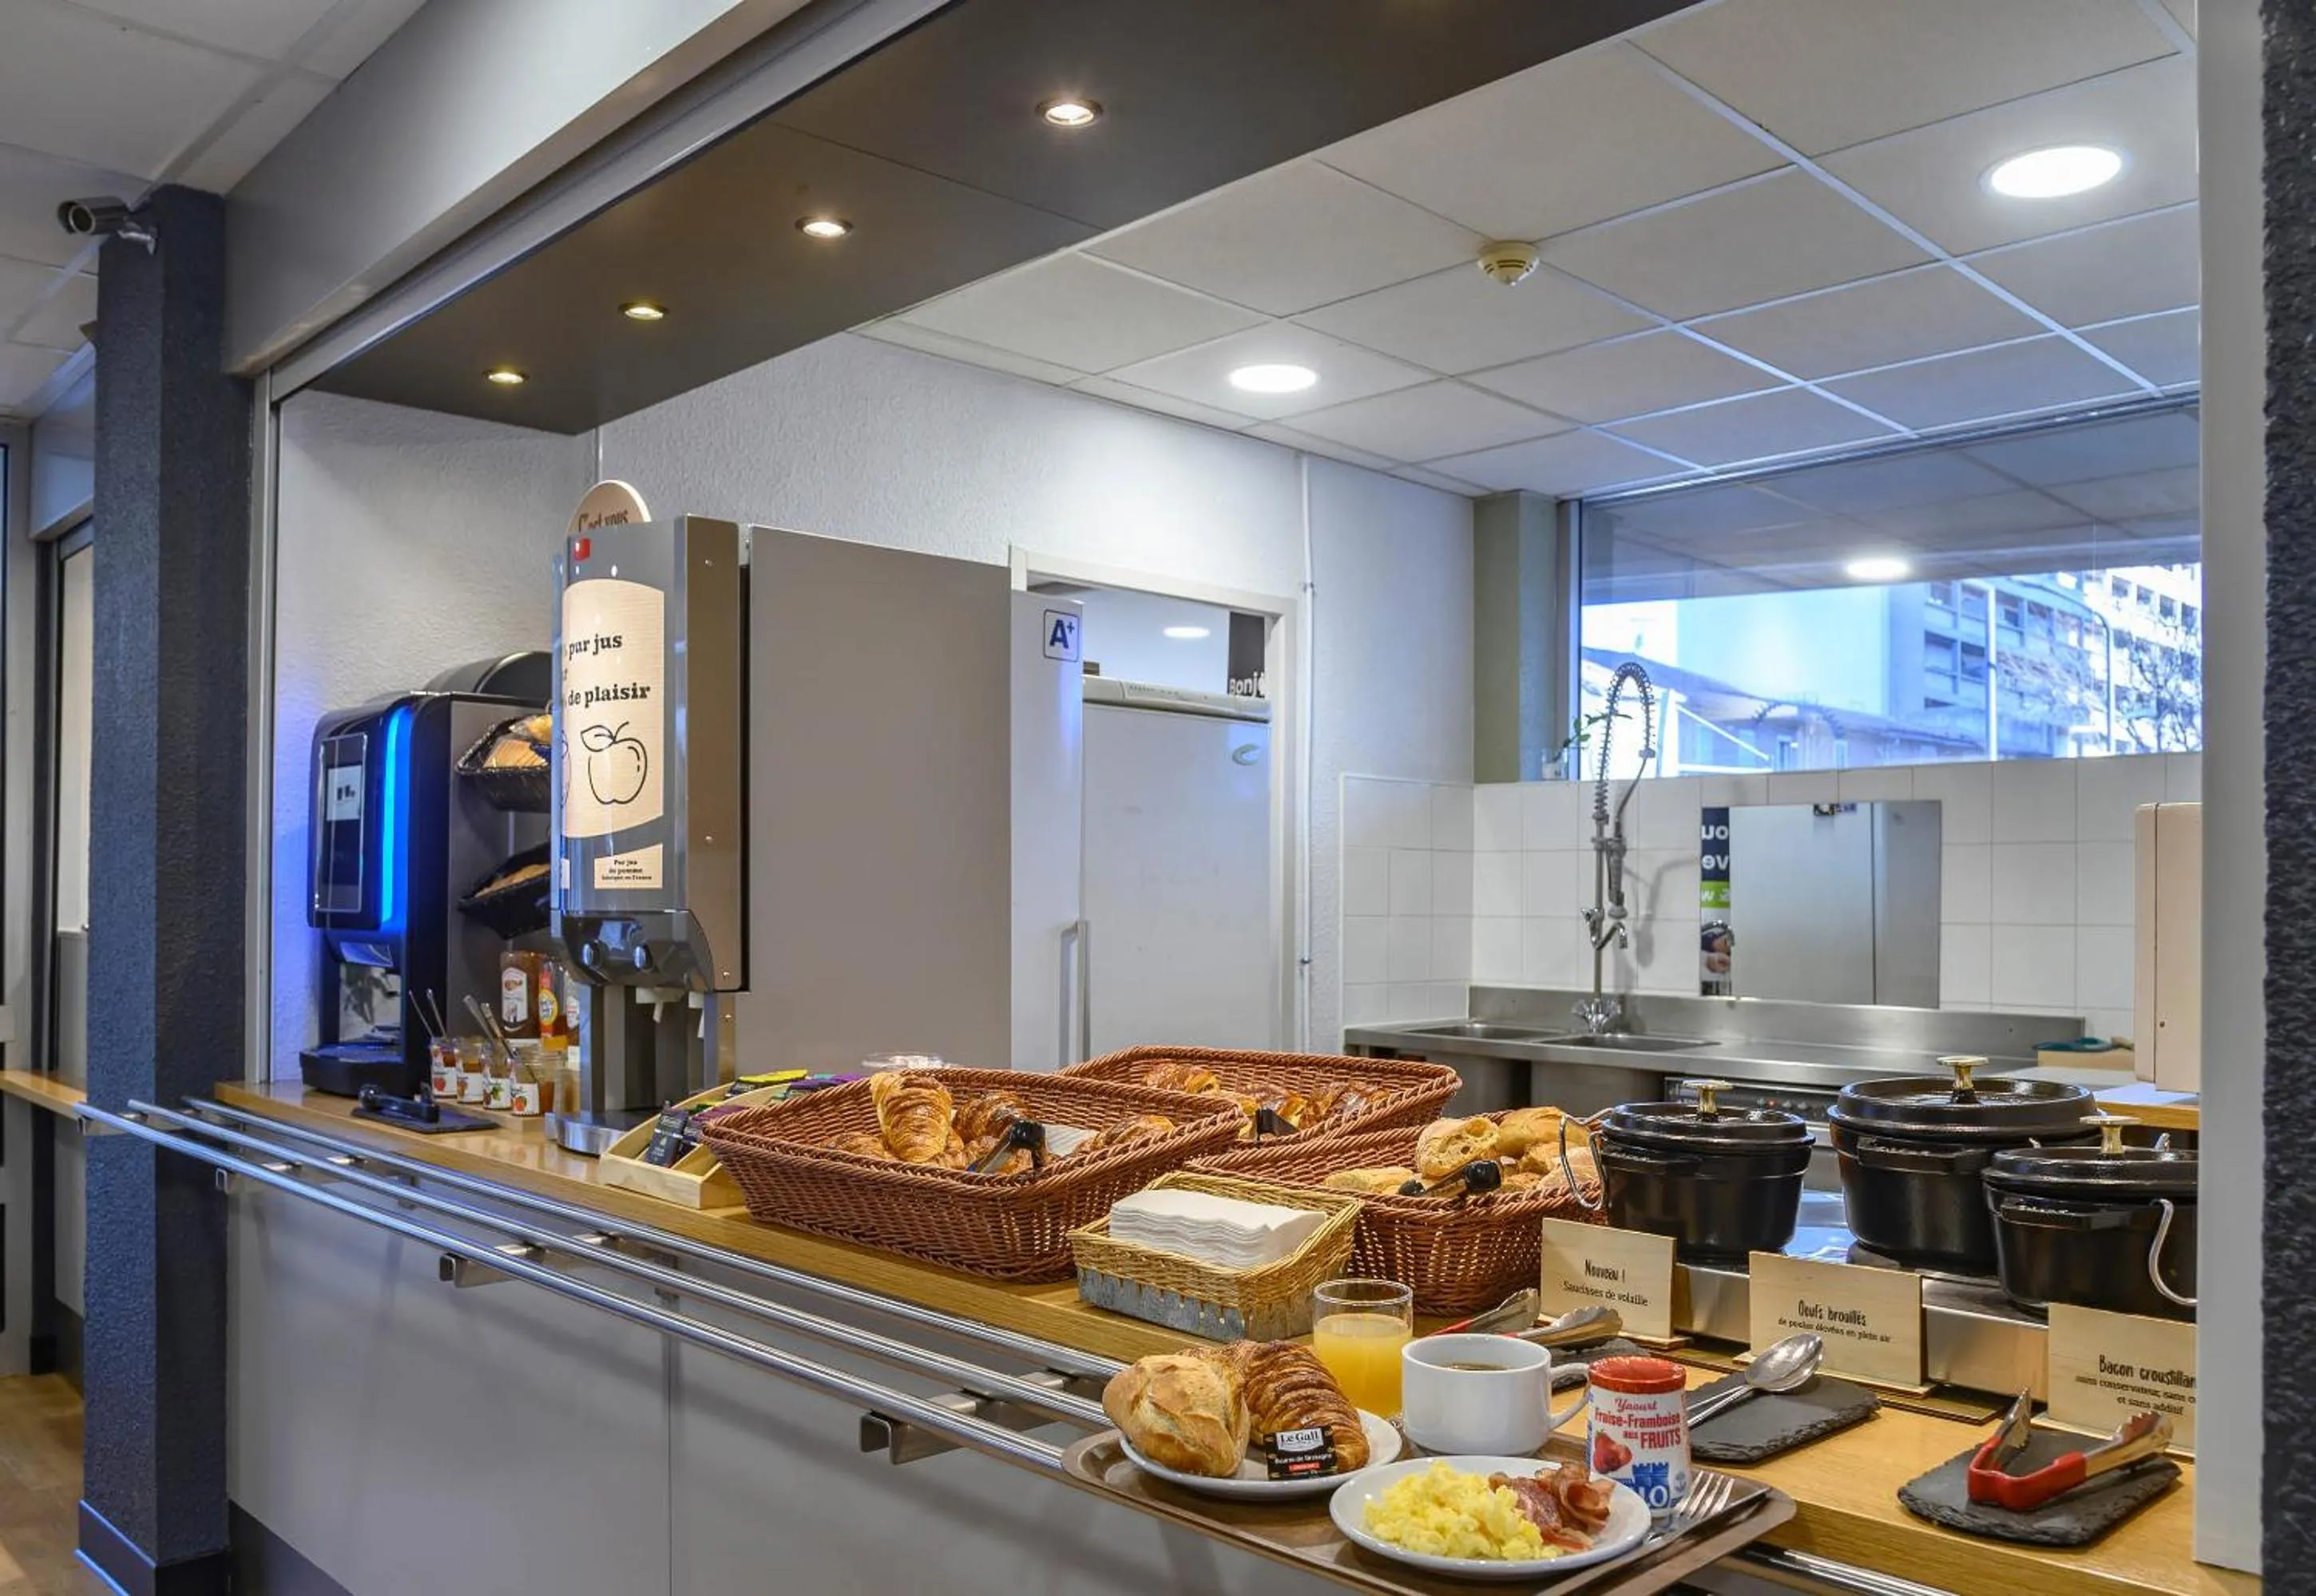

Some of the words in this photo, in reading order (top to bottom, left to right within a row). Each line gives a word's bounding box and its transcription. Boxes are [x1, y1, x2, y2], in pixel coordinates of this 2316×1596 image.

[569, 638, 590, 660] pur
[593, 633, 623, 655] jus
[568, 688, 581, 706] de
[584, 682, 651, 708] plaisir
[1584, 1258, 1619, 1281] Nouveau
[1564, 1280, 1604, 1297] Saucisses
[1605, 1289, 1616, 1300] de
[1617, 1291, 1648, 1306] volaille
[1778, 1317, 1787, 1325] de
[1827, 1305, 1866, 1326] brouillés
[2099, 1354, 2134, 1378] Bacon
[2139, 1367, 2195, 1388] croustillan
[1615, 1398, 1658, 1412] Yaourt
[2116, 1396, 2127, 1405] et
[2128, 1398, 2151, 1409] sans
[1280, 1433, 1294, 1444] Le
[1295, 1430, 1319, 1441] Gall
[1640, 1428, 1681, 1450] FRUITS
